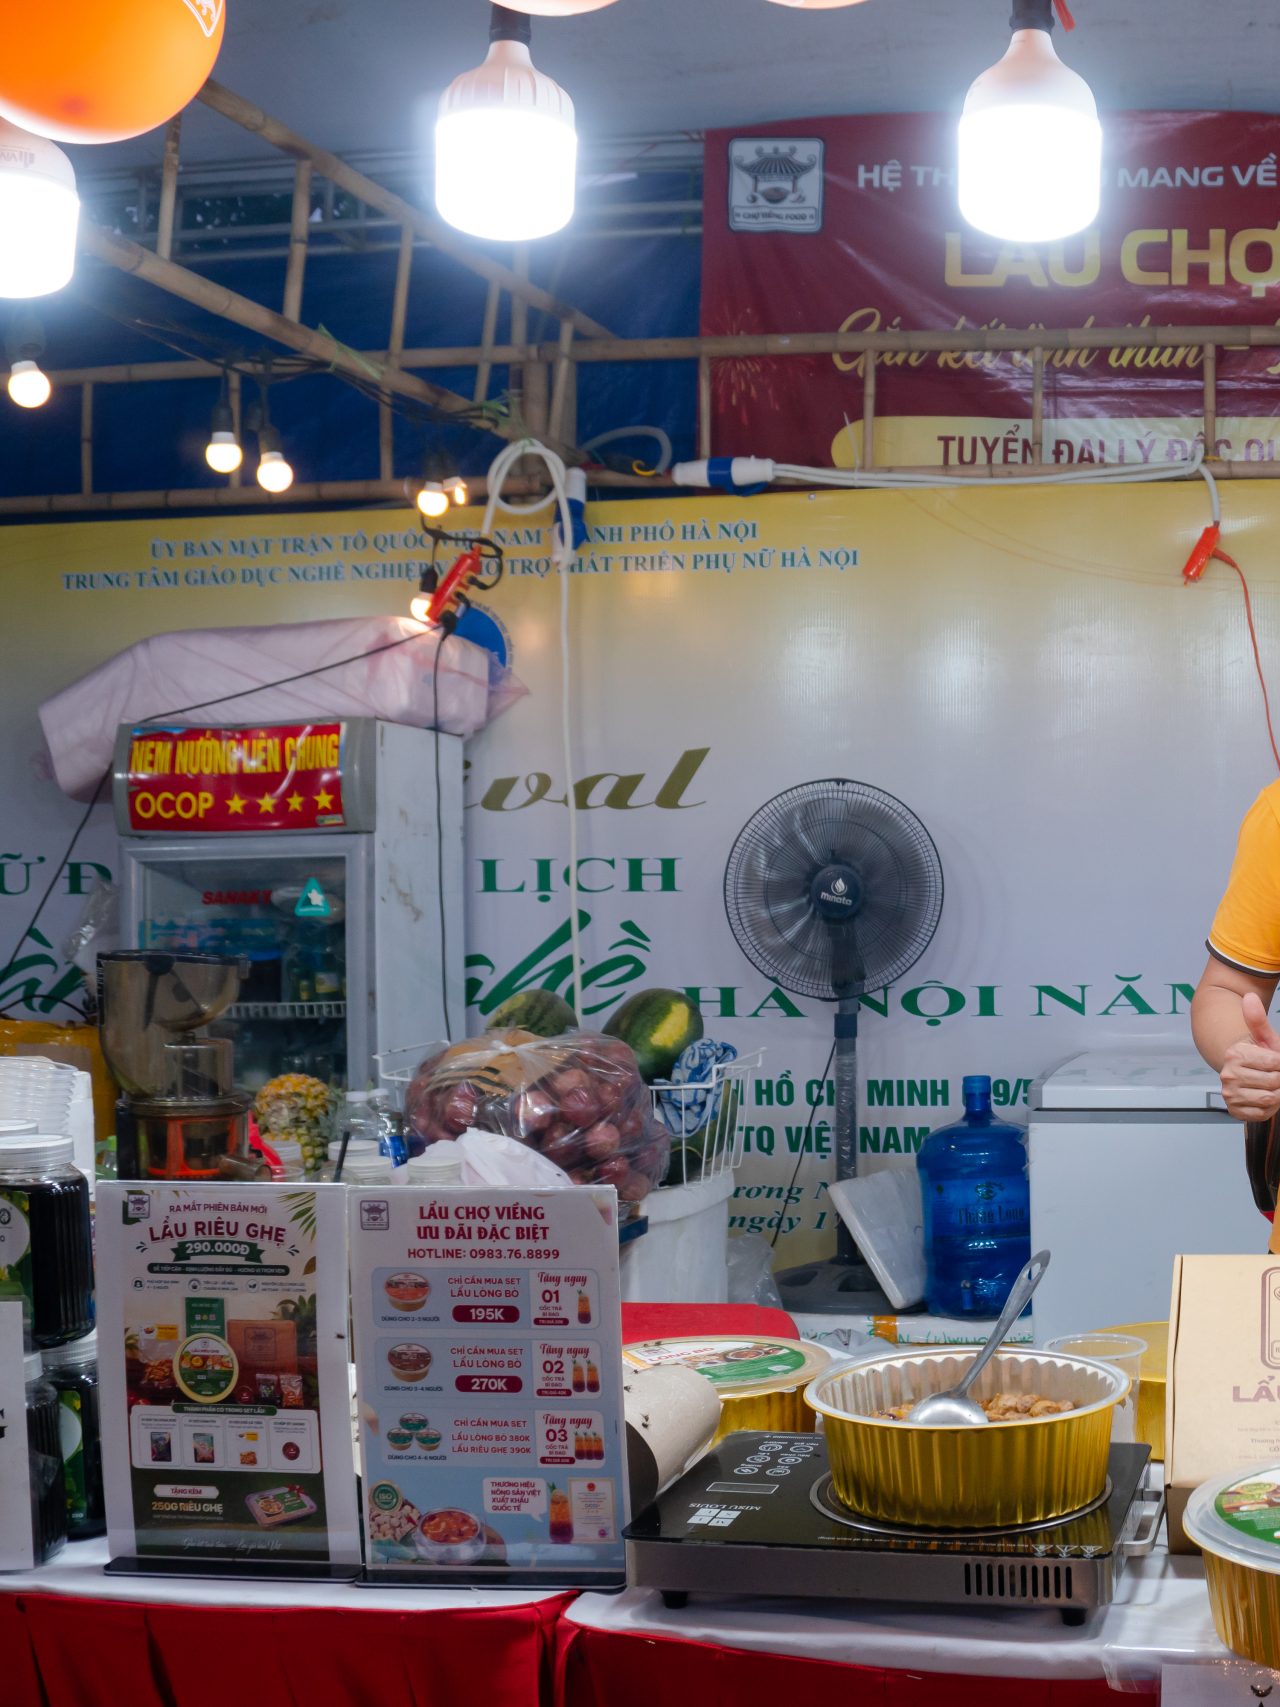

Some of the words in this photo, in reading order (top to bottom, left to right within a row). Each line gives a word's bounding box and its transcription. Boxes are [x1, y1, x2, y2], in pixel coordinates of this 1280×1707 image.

[858, 160, 902, 188] HỆ
[1118, 167, 1223, 188] MANG
[1233, 152, 1278, 187] VỀ
[184, 540, 223, 557] BAN
[279, 534, 333, 556] TRẬN
[494, 528, 542, 545] NAM
[630, 520, 675, 542] PHỐ
[681, 519, 711, 540] HÀ
[718, 520, 757, 543] NỘI
[63, 571, 130, 590] TRUNG
[135, 567, 179, 587] TÂM
[185, 565, 236, 586] GIÁO
[241, 567, 282, 587] DỤC
[506, 557, 550, 577] TRỢ
[692, 552, 735, 573] PHỤ
[743, 548, 776, 568] NỮ
[781, 547, 812, 567] HÀ
[819, 548, 858, 570] NỘI
[132, 741, 172, 774] NEM
[175, 731, 237, 775] NƯỚNG
[243, 733, 281, 773] LIÊN
[285, 734, 340, 770] CHUNG
[135, 791, 215, 820] OCOP
[476, 857, 683, 903] LỊCH
[820, 891, 853, 906] minato
[754, 1070, 795, 1107] HỒ
[866, 1079, 949, 1107] MINH
[169, 1205, 182, 1213] RA
[204, 1201, 230, 1213] PHIÊN
[419, 1200, 449, 1220] LẨU
[454, 1204, 491, 1224] CHỢ
[496, 1202, 545, 1221] VIỀNG
[149, 1216, 187, 1242] LẨU
[194, 1217, 239, 1237] RIÊU
[246, 1223, 287, 1247] GHẸ
[416, 1226, 440, 1241] ƯU
[445, 1224, 473, 1241] ĐÃI
[516, 1225, 551, 1244] BIỆT
[185, 1242, 250, 1256] 290.000Đ
[408, 1249, 467, 1260] HOTLINE:
[470, 1249, 560, 1260] 0983.76.8899
[485, 1277, 503, 1285] MUA
[506, 1277, 521, 1285] SET
[541, 1289, 560, 1303] 01
[470, 1307, 504, 1321] 195K
[541, 1360, 565, 1375] 02
[471, 1378, 507, 1391] 270K
[545, 1428, 568, 1443] 03
